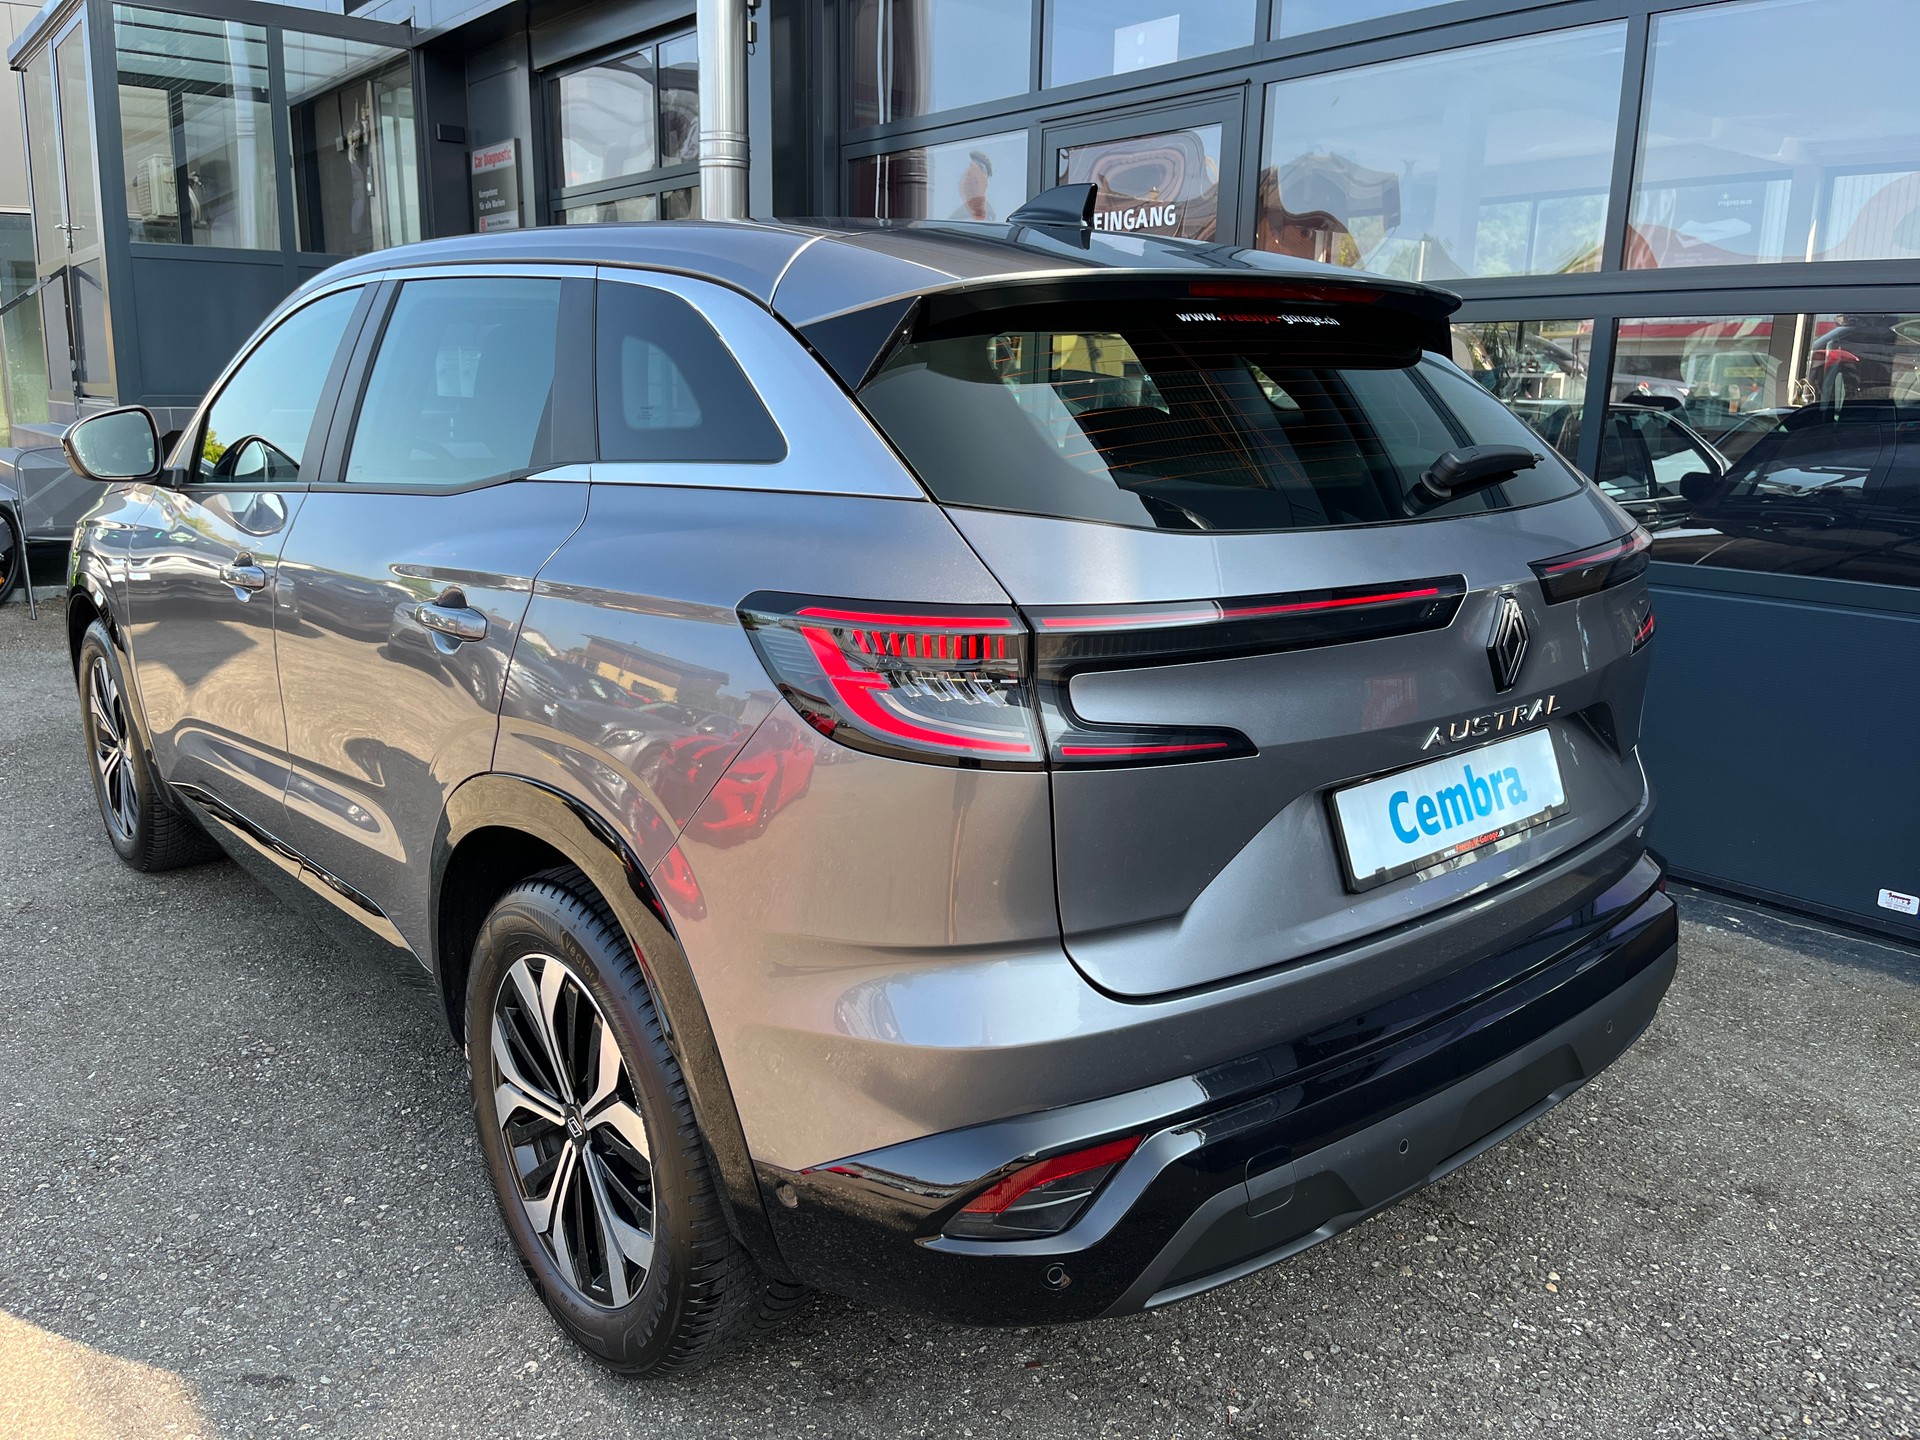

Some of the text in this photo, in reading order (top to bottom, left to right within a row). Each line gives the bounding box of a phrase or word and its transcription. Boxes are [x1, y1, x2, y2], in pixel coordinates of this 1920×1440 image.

[474, 146, 512, 169] Car Diagnostic
[1093, 204, 1176, 231] EINGANG
[1420, 694, 1561, 751] AUSTRAL
[1388, 764, 1528, 844] Cembra
[564, 937, 595, 980] Vector
